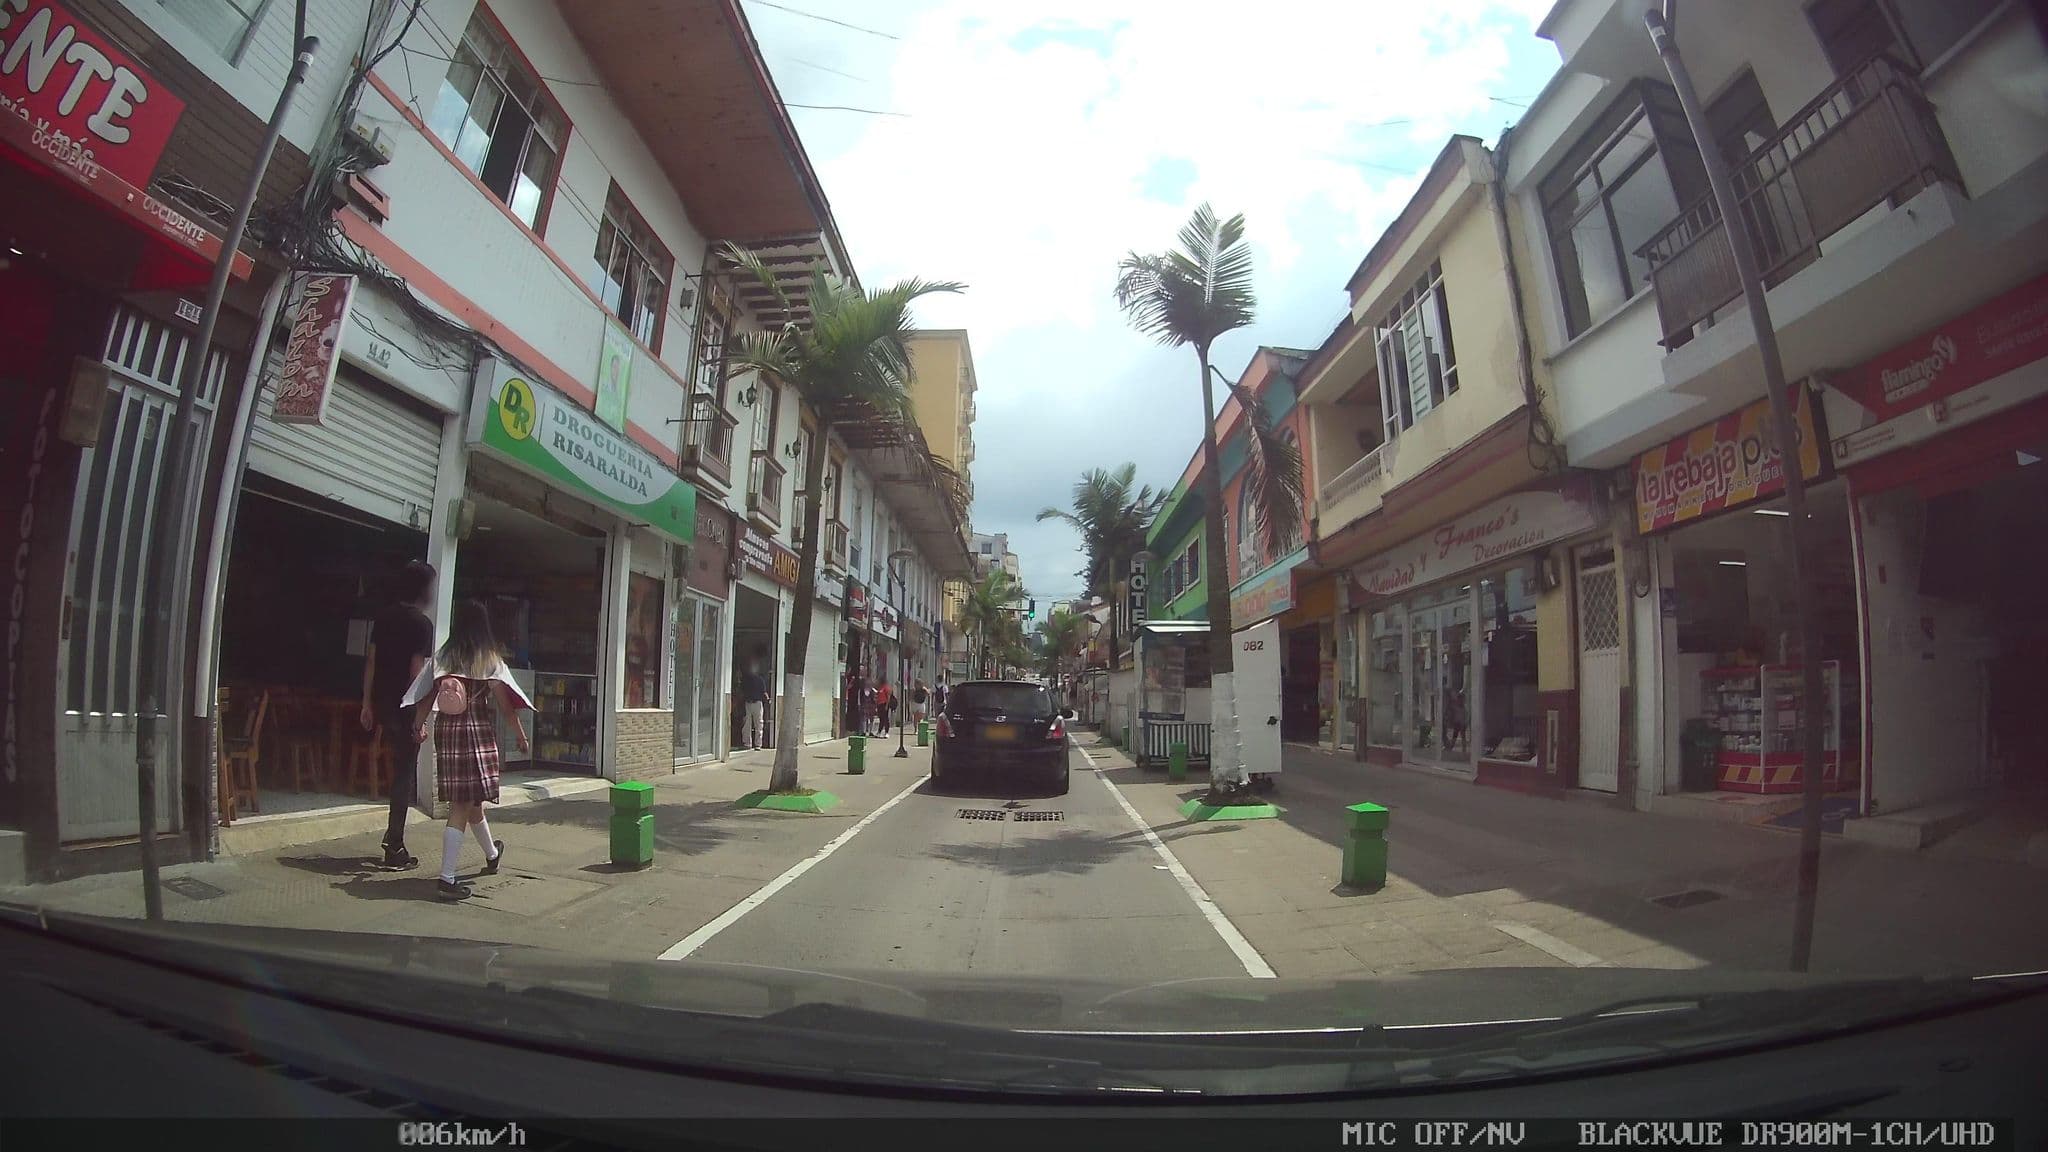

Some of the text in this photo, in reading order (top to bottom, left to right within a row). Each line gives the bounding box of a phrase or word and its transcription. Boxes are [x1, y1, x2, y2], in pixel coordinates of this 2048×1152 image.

[32, 129, 99, 179] OCCIDENTE
[142, 195, 207, 242] OCCIDENTE
[1880, 350, 1944, 392] flamingo
[552, 431, 648, 497] RISARALDA
[1665, 443, 1737, 496] rebaja
[1130, 559, 1146, 634] HOTE
[1368, 562, 1416, 593] Navidad
